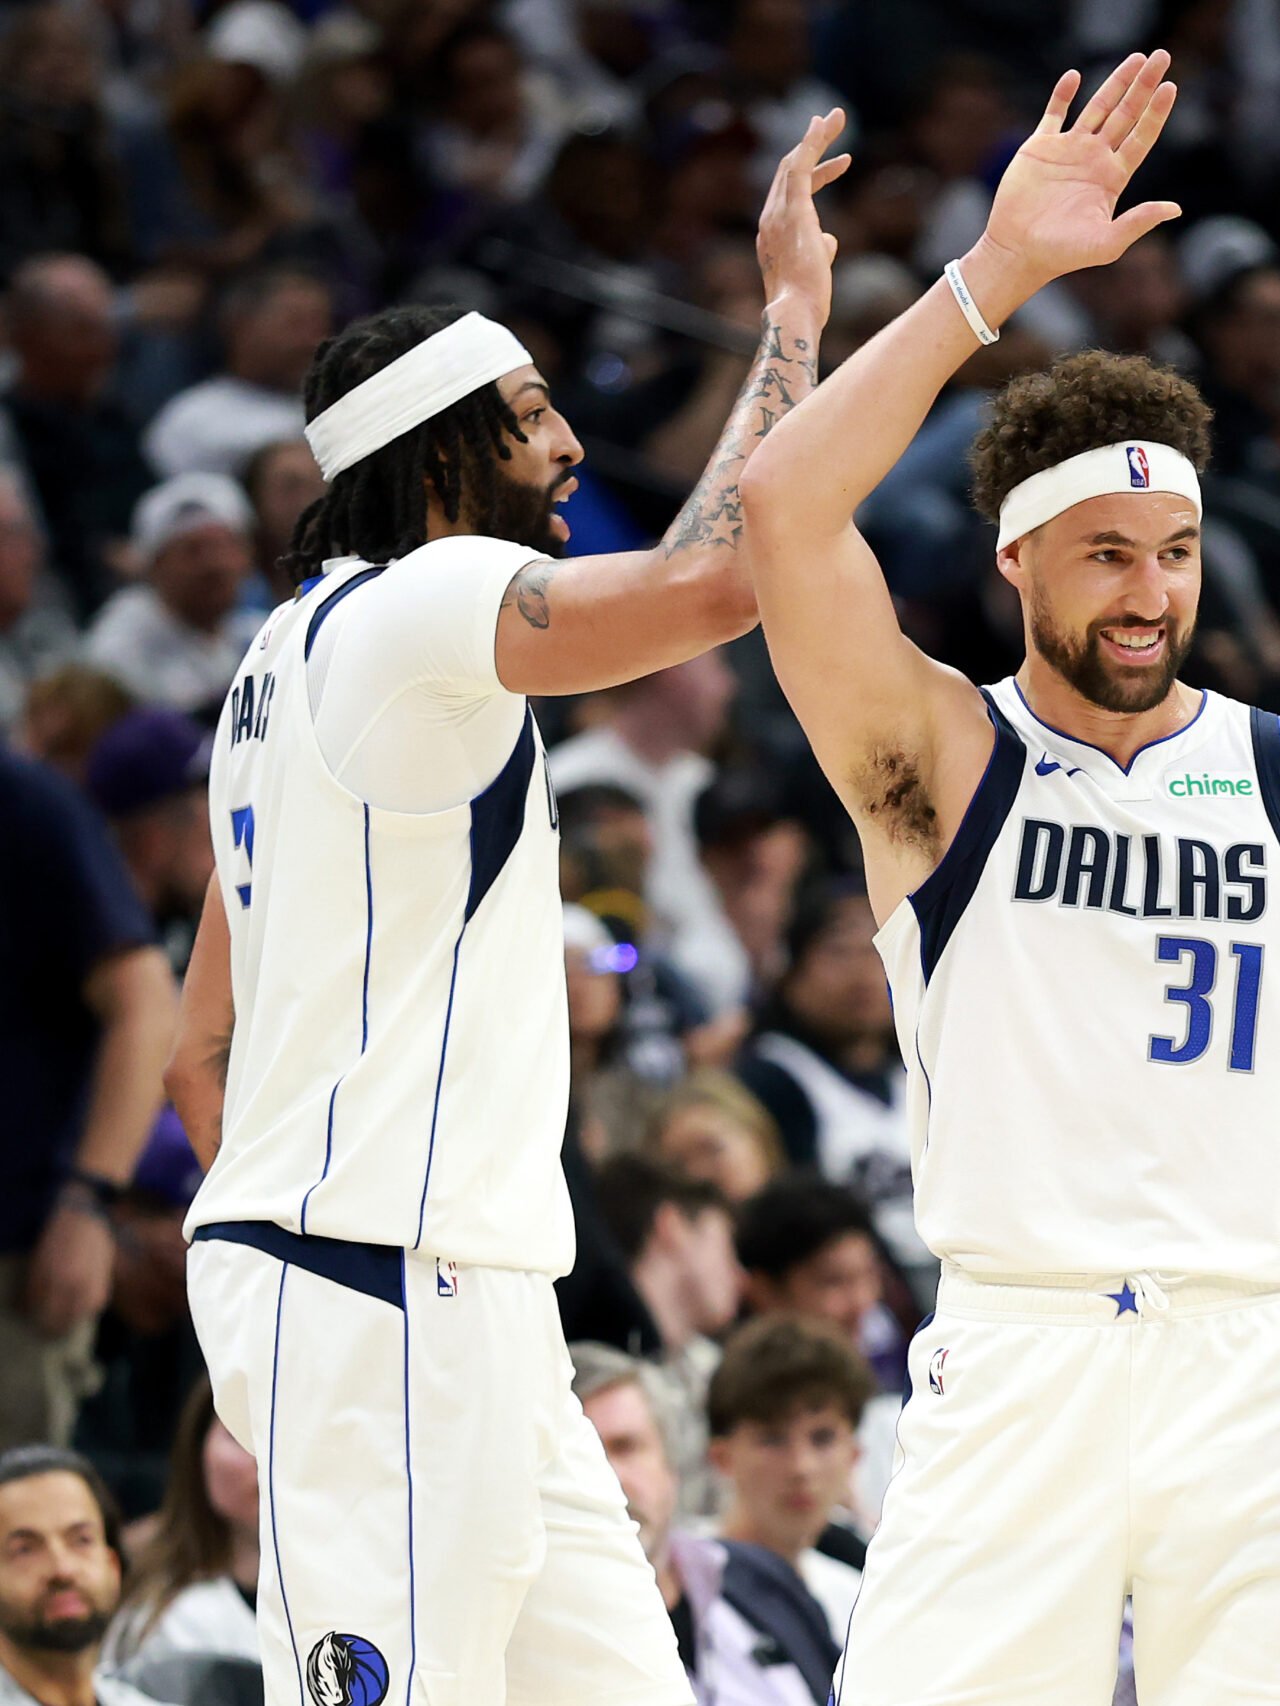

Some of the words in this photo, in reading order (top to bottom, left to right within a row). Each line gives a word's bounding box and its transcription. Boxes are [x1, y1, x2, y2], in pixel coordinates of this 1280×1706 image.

[1169, 774, 1252, 797] chime
[1010, 816, 1267, 924] DALLAS
[1147, 933, 1265, 1075] 31
